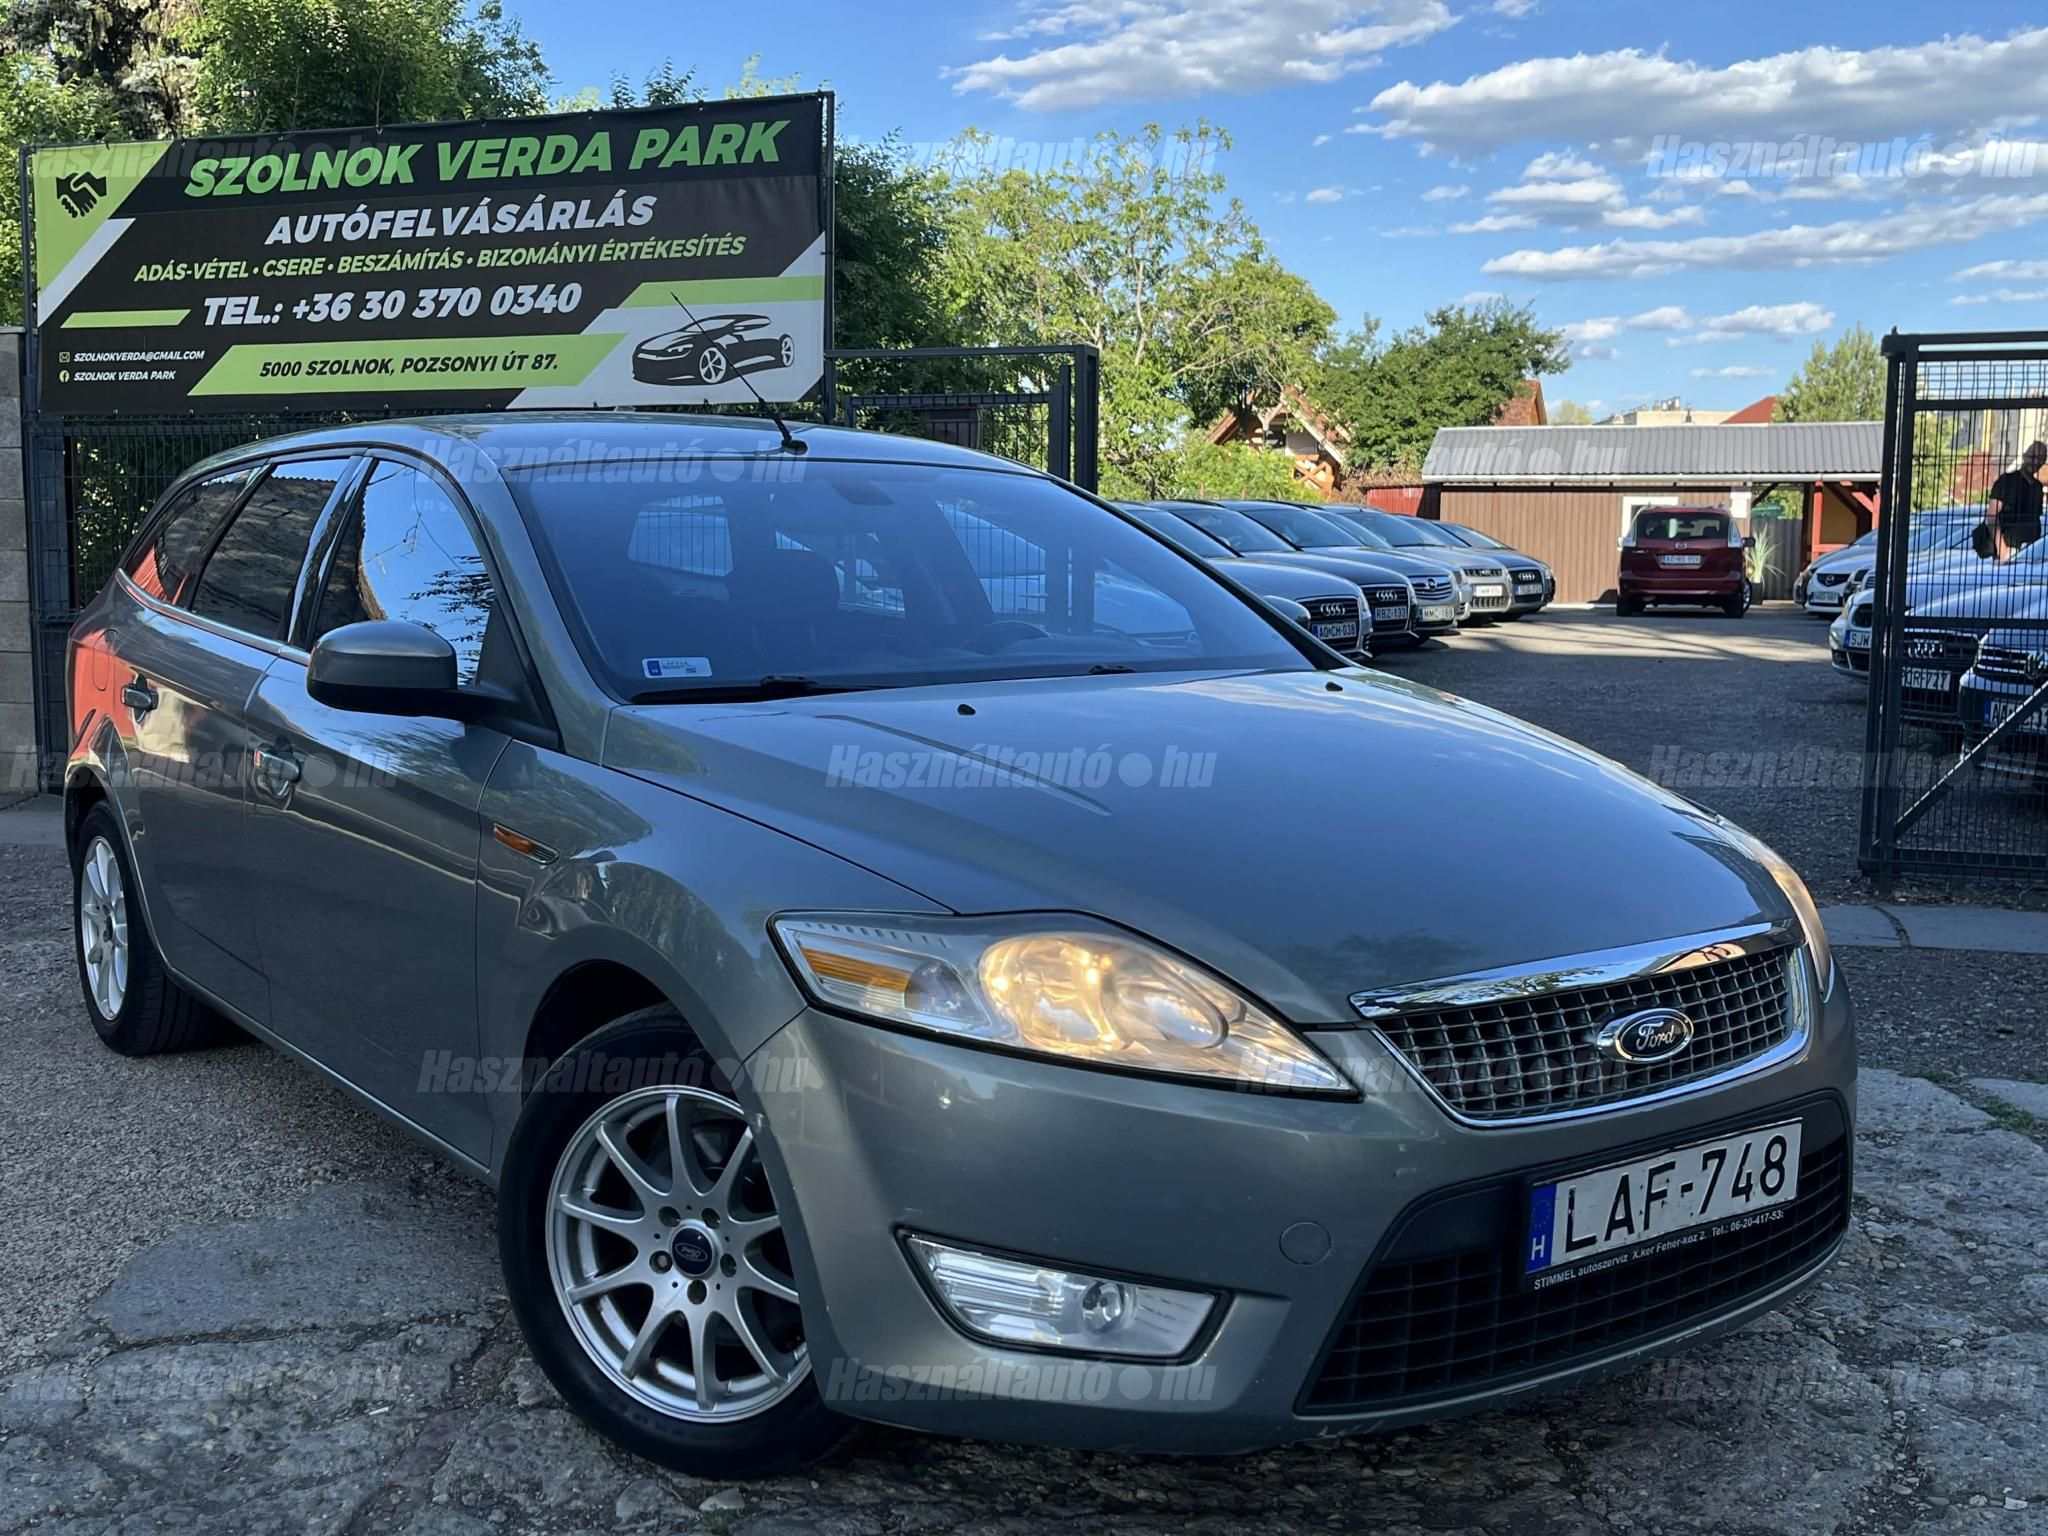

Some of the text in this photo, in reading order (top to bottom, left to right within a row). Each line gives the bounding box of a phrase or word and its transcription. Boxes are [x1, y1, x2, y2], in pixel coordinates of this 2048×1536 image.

[185, 119, 791, 198] SZOLNOK VERDA PARK
[264, 188, 657, 245] AUTÓFELVÁSÁRLÁS
[134, 232, 747, 283] ADÁS-VÉTEL CSERE BESZÁMÍTÁS BIZOMÁNYI ÉRTÉKESÍTÉS
[204, 282, 582, 326] TEL.: +36 30 370 0340
[73, 349, 205, 363] SZOLNOKVERDA@GMAIL.COM
[259, 351, 558, 378] 5000 SZOLNOK, POZSONYI ÚT 87.
[73, 370, 176, 382] SZOLNOK VERDA PARK
[1851, 633, 1870, 646] SJW
[1636, 1021, 1676, 1050] Ford
[1565, 1134, 1788, 1253] LAF-748
